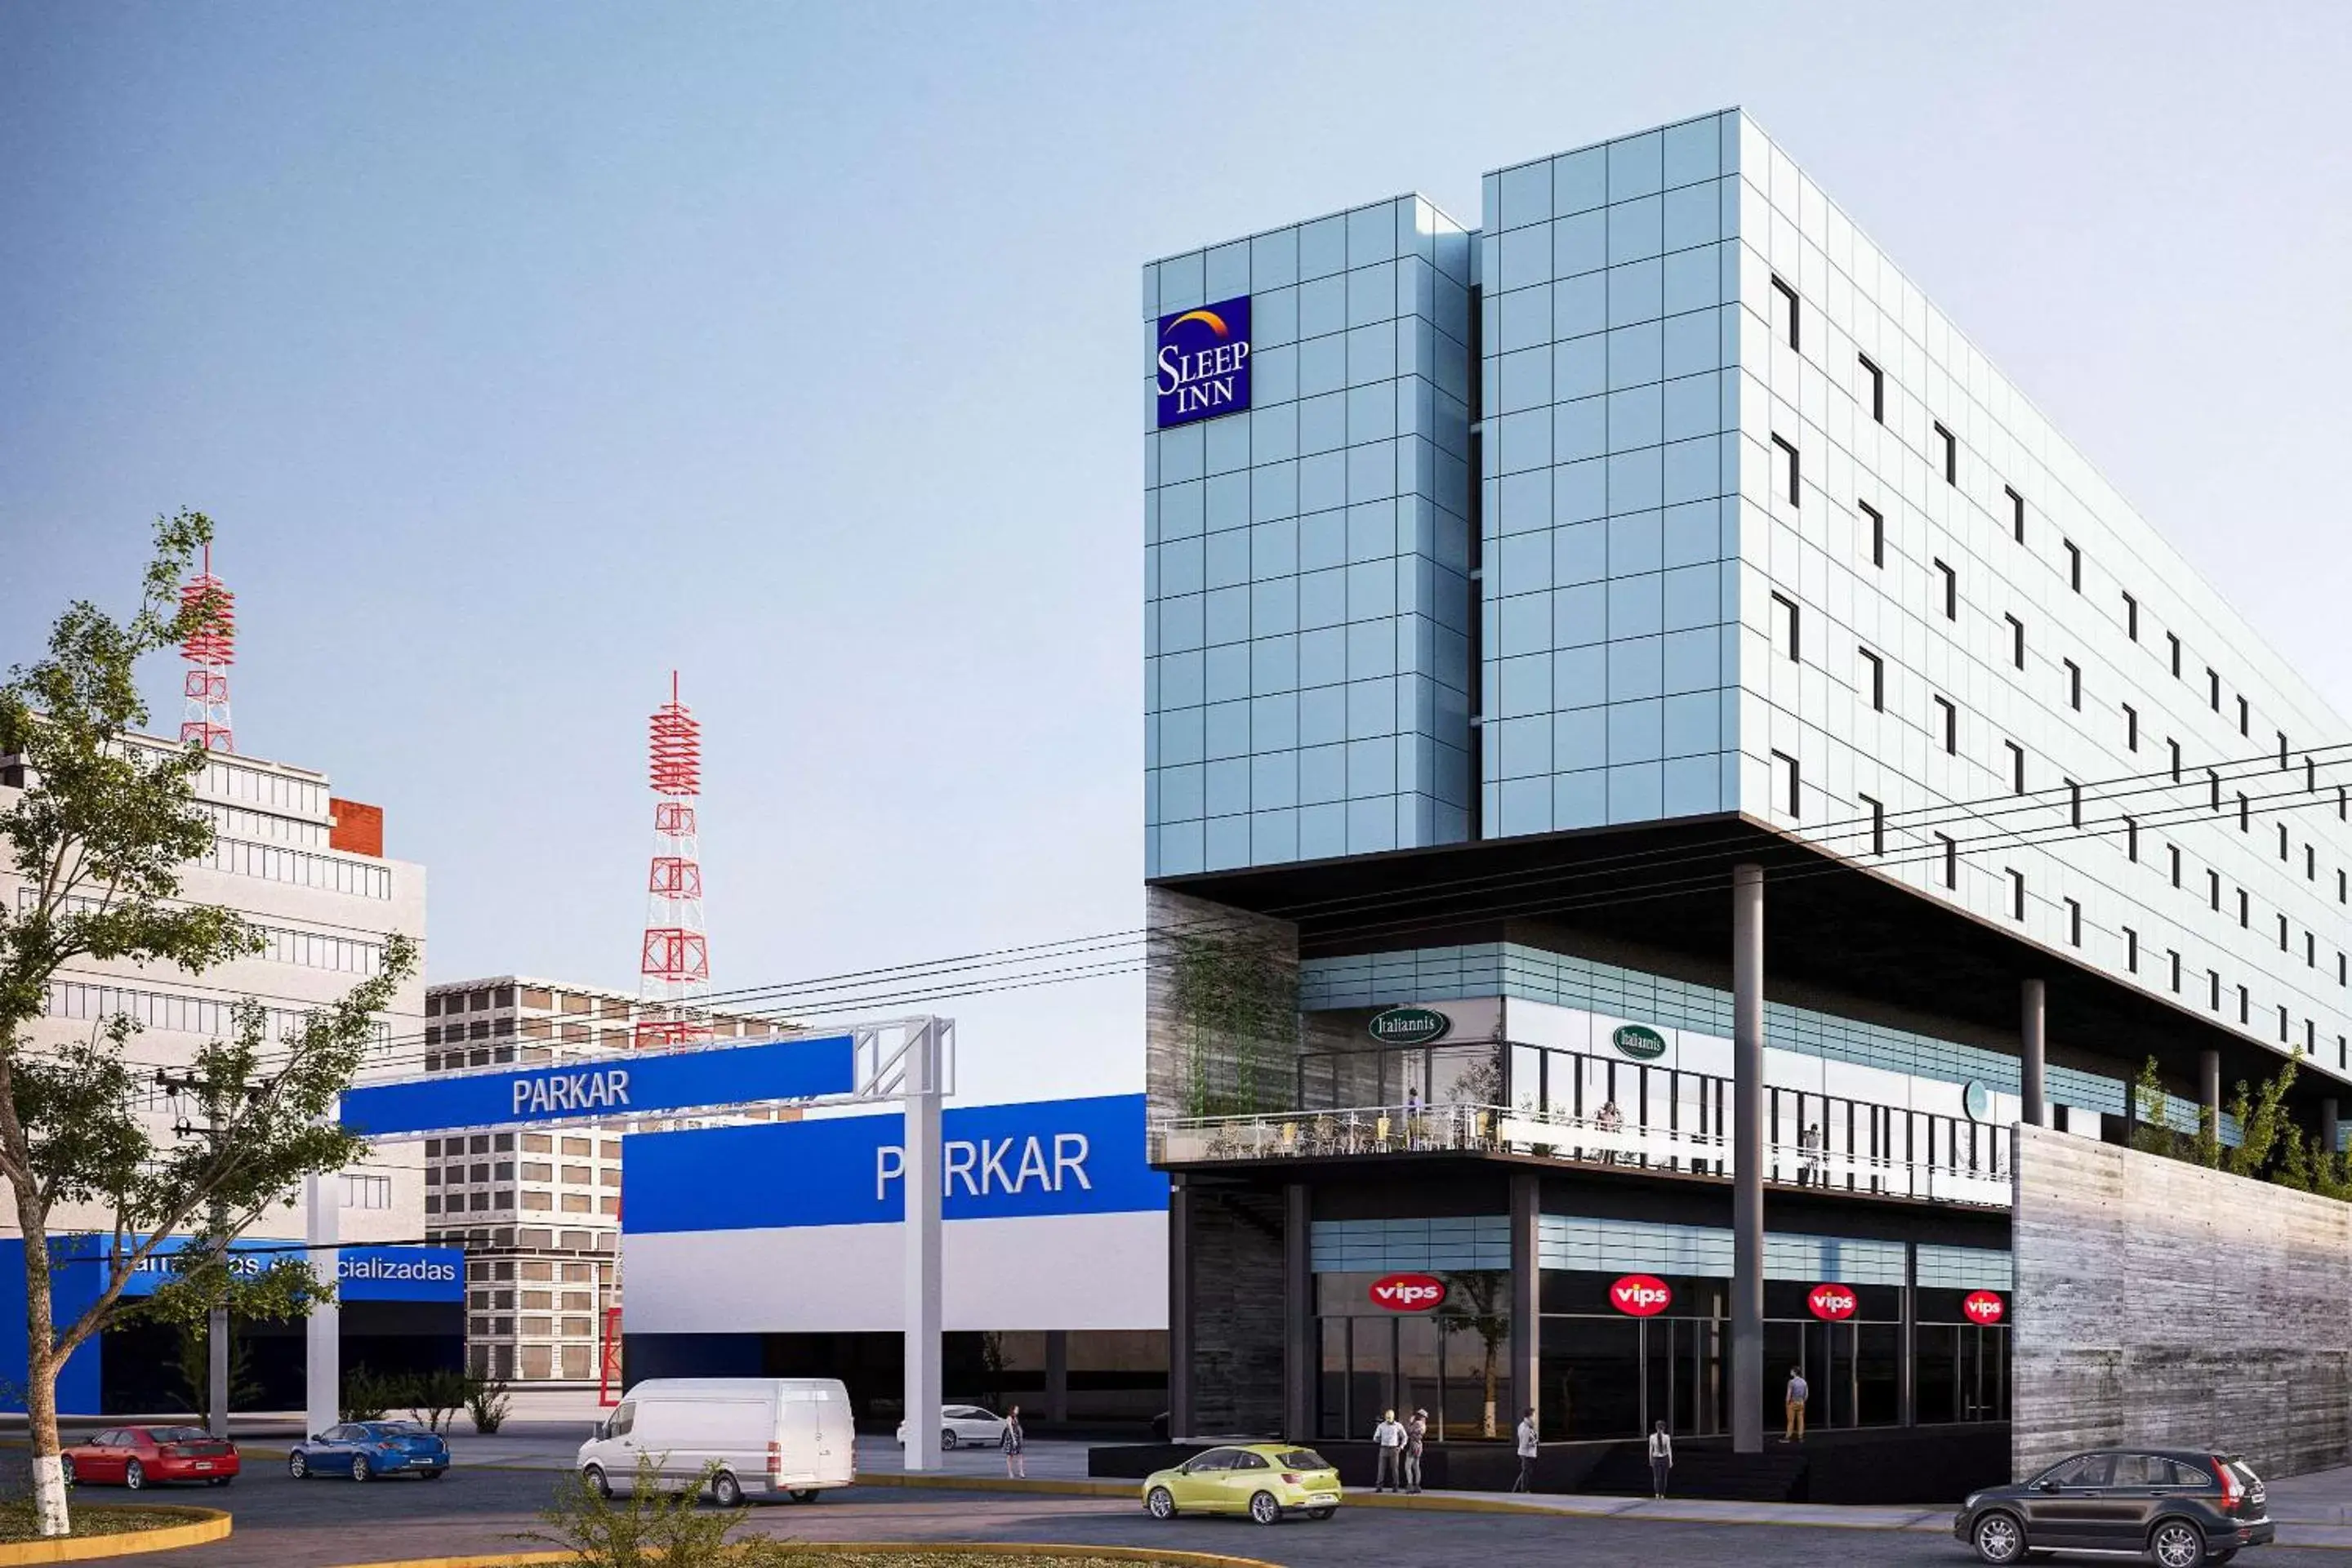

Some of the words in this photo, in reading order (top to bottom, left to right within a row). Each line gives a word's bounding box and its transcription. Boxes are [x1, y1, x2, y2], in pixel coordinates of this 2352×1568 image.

[1157, 341, 1250, 395] SLEEP
[1177, 376, 1235, 413] INN
[513, 1070, 630, 1115] PARKAR
[877, 1133, 1092, 1200] PRKAR
[1375, 1282, 1437, 1303] vips
[1616, 1283, 1667, 1307] vips
[1813, 1291, 1853, 1313] vips
[1967, 1298, 2000, 1317] vips
